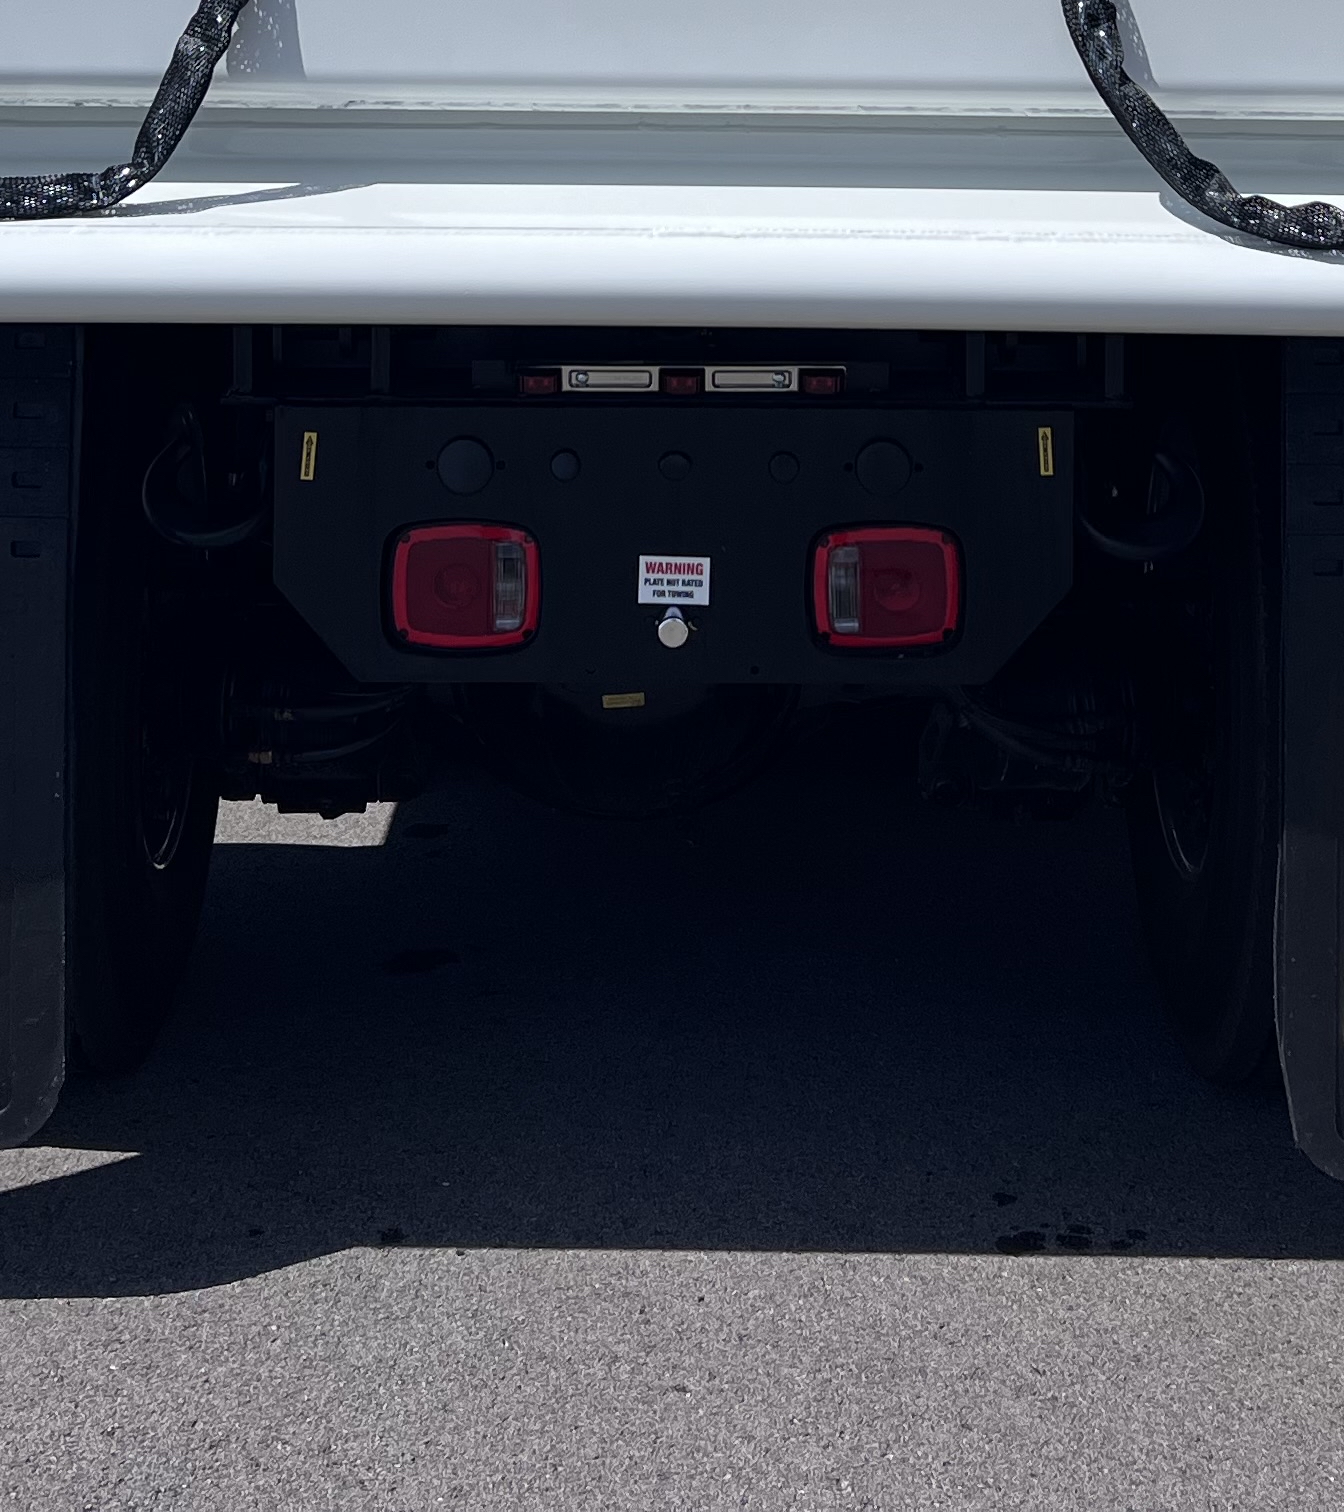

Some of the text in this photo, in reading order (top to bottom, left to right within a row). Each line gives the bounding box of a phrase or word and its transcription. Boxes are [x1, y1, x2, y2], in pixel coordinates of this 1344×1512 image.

[645, 561, 704, 576] WARNING
[644, 578, 665, 587] PLATE
[681, 578, 704, 588] RATED
[652, 589, 666, 598] FOR
